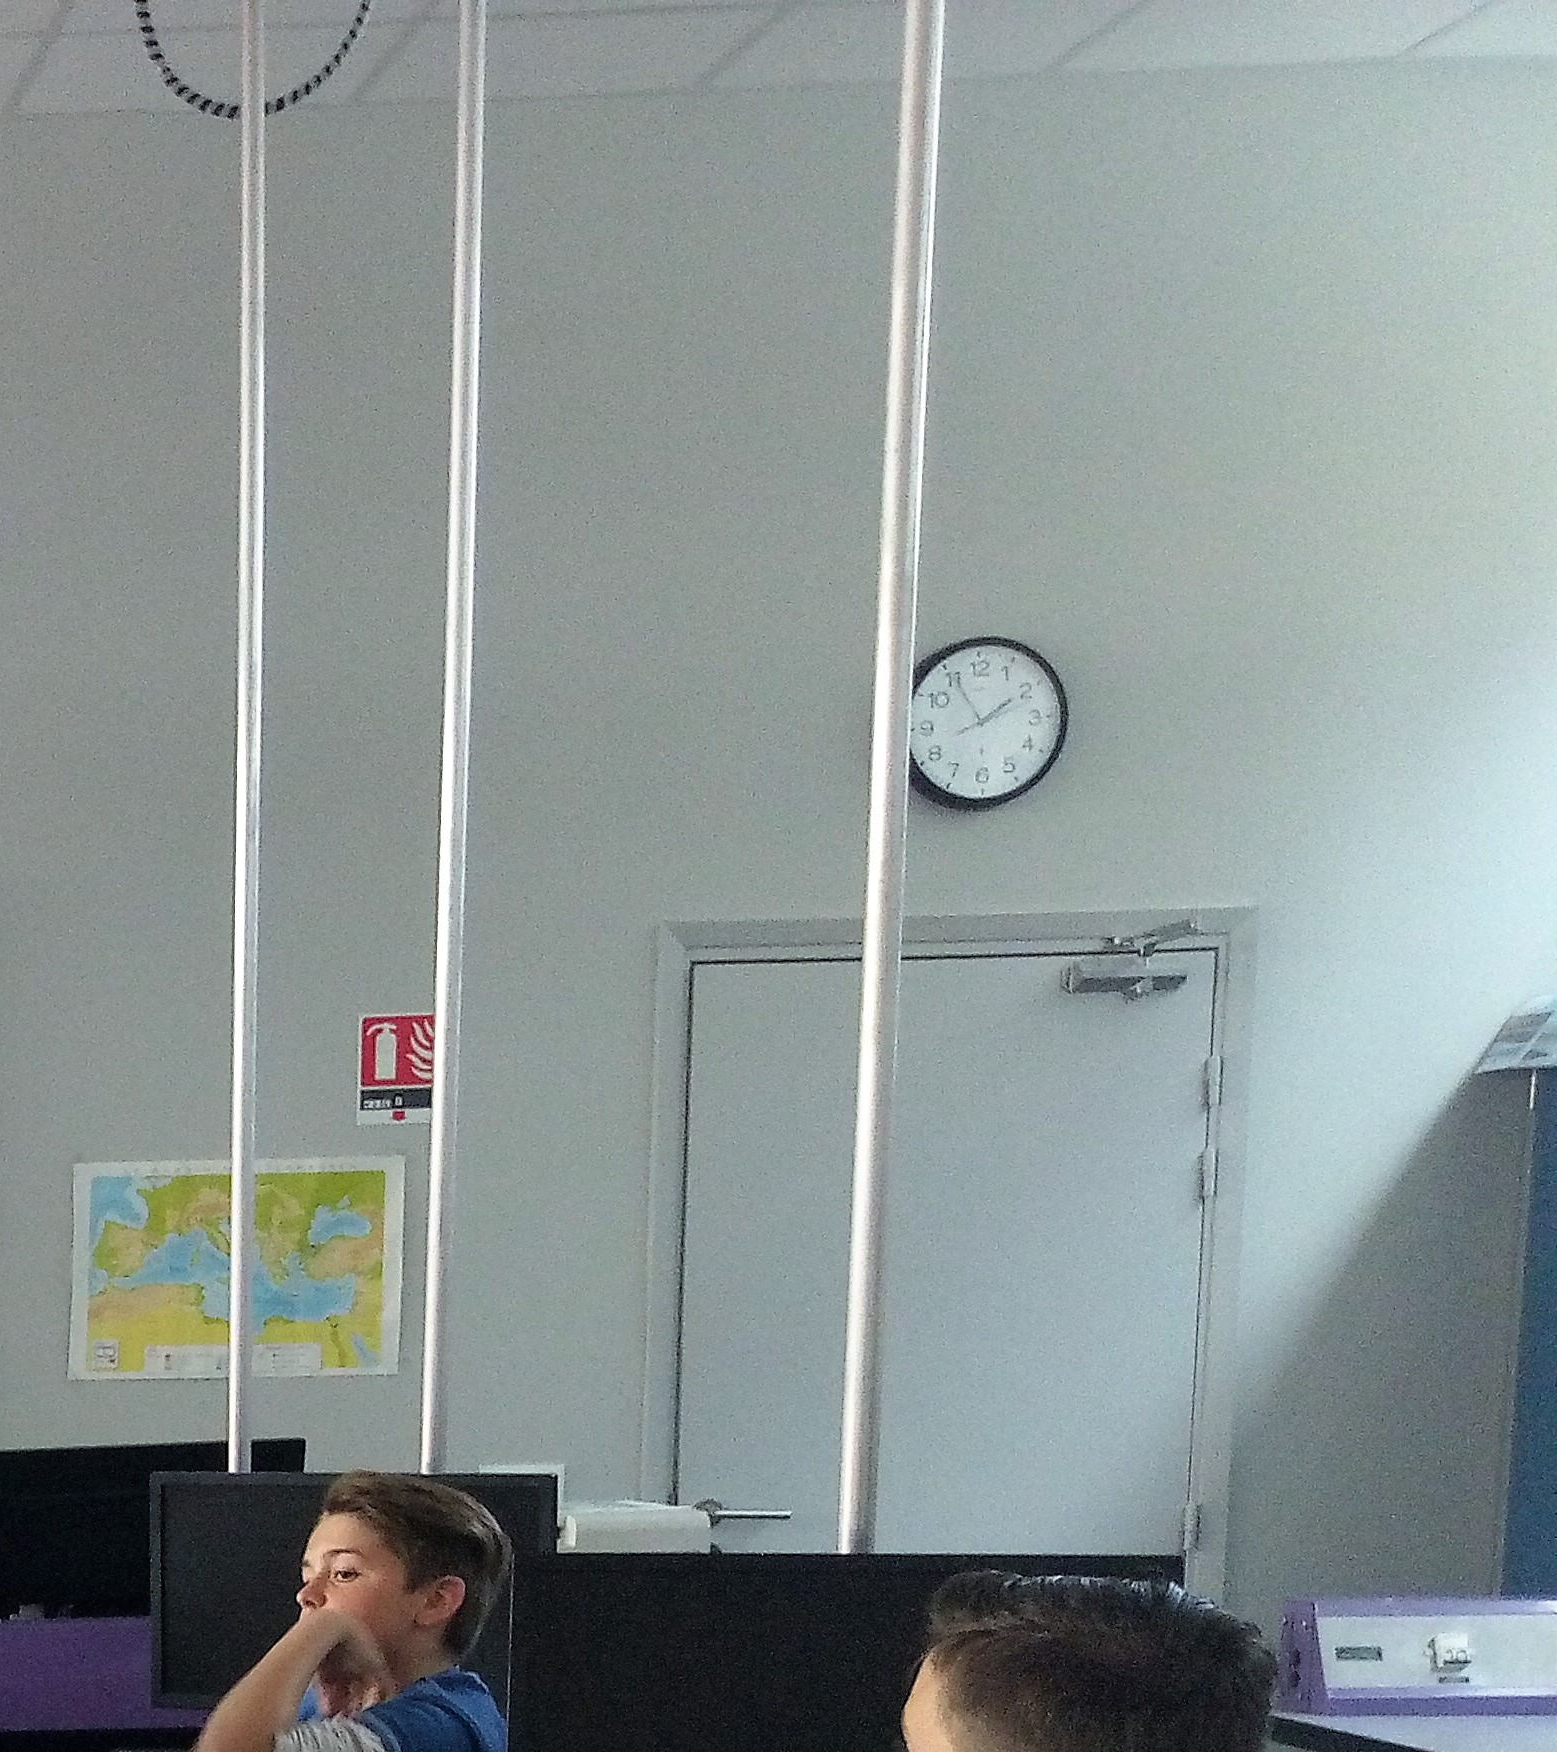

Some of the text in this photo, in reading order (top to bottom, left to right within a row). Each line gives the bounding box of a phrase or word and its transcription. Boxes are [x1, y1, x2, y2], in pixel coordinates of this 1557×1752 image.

[971, 661, 989, 676] 12
[1000, 665, 1010, 681] 1
[1020, 683, 1032, 699] 2
[929, 691, 949, 708] 10
[1029, 710, 1041, 726] 3
[920, 720, 934, 736] 9
[1022, 734, 1033, 750] 4
[928, 745, 941, 761] 8
[948, 762, 959, 777] 7
[1003, 756, 1015, 772] 5
[975, 767, 989, 783] 6
